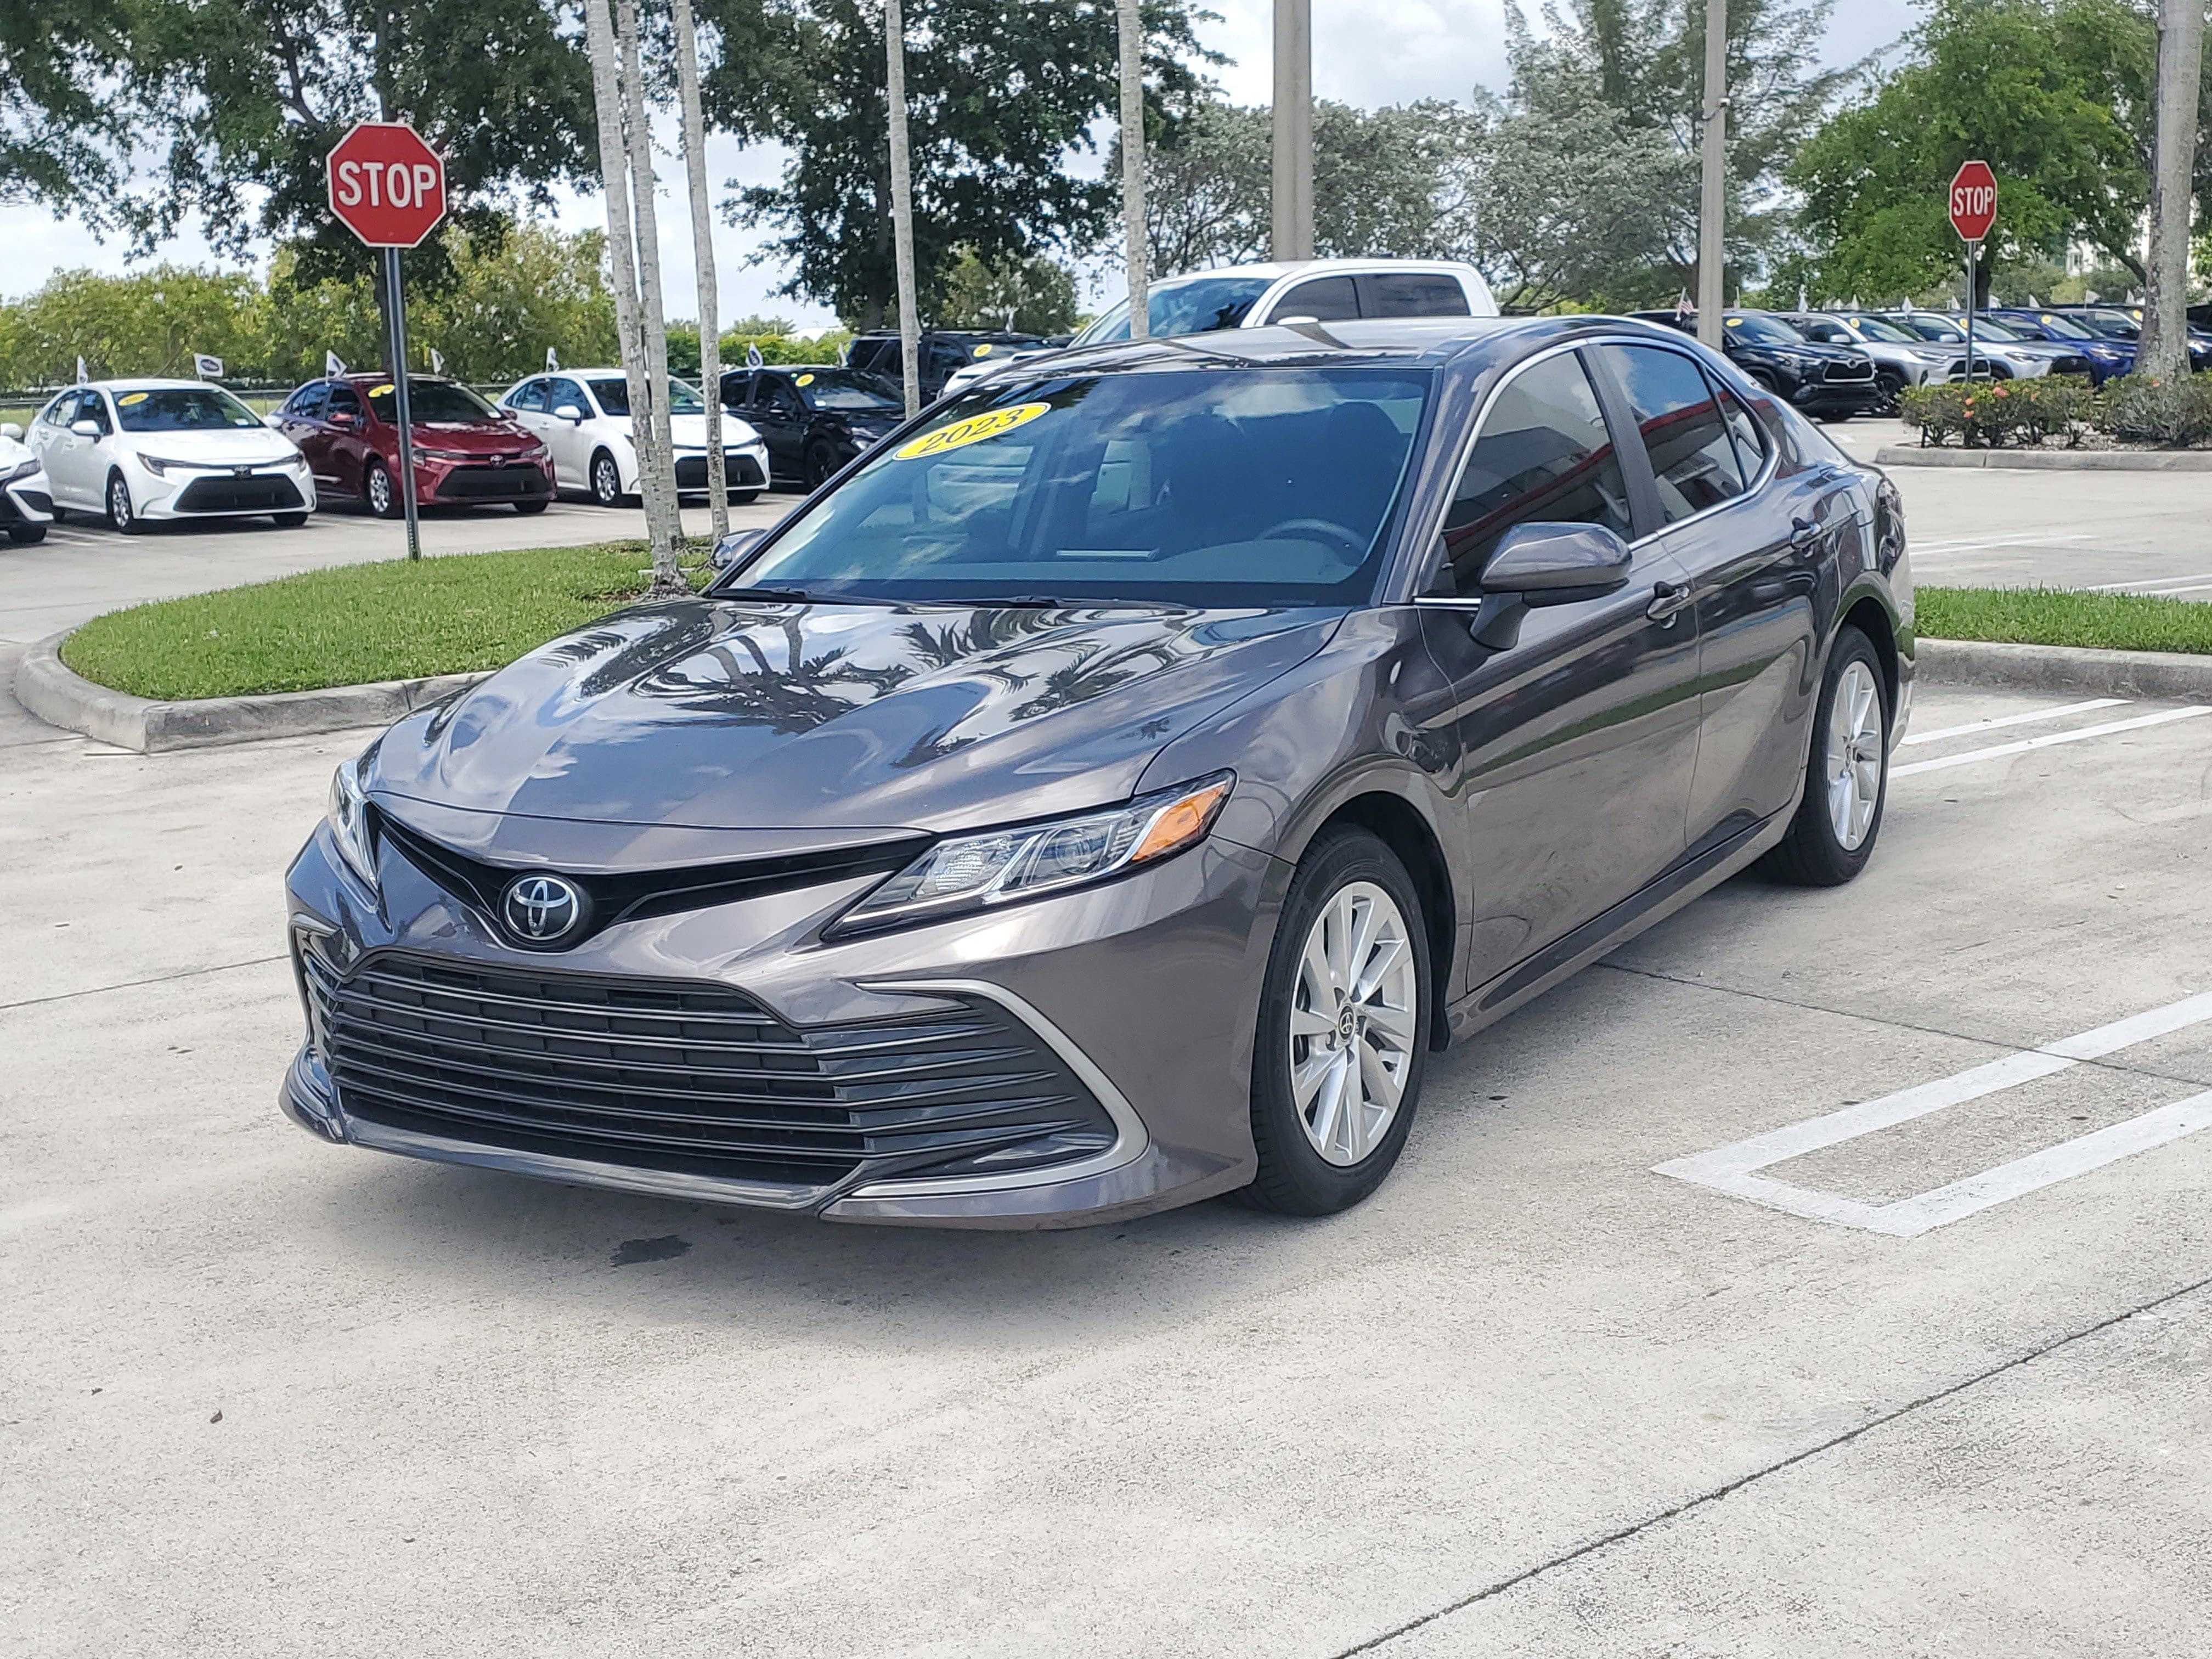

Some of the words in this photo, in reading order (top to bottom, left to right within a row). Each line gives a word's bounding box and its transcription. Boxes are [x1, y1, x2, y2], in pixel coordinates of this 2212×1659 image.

[338, 161, 437, 208] STOP
[1953, 186, 1994, 217] STOP
[918, 409, 1025, 454] 2023
